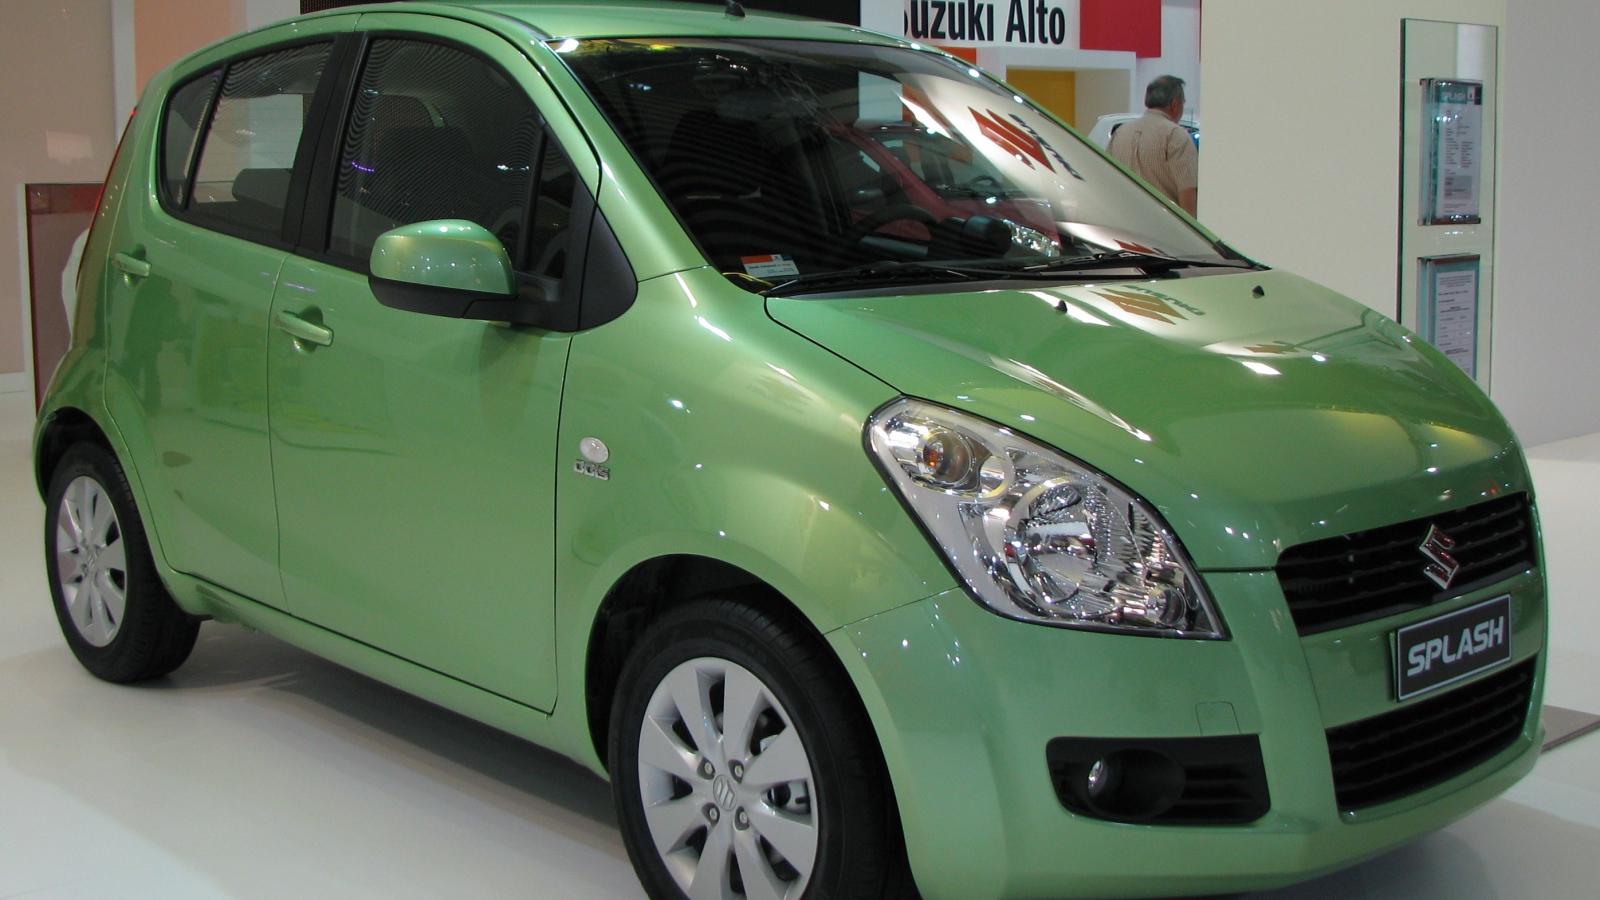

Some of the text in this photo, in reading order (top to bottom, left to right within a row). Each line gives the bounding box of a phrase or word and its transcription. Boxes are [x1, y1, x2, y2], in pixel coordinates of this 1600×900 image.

[904, 0, 1065, 45] uzuki Alto
[1407, 615, 1504, 677] SPLASH
